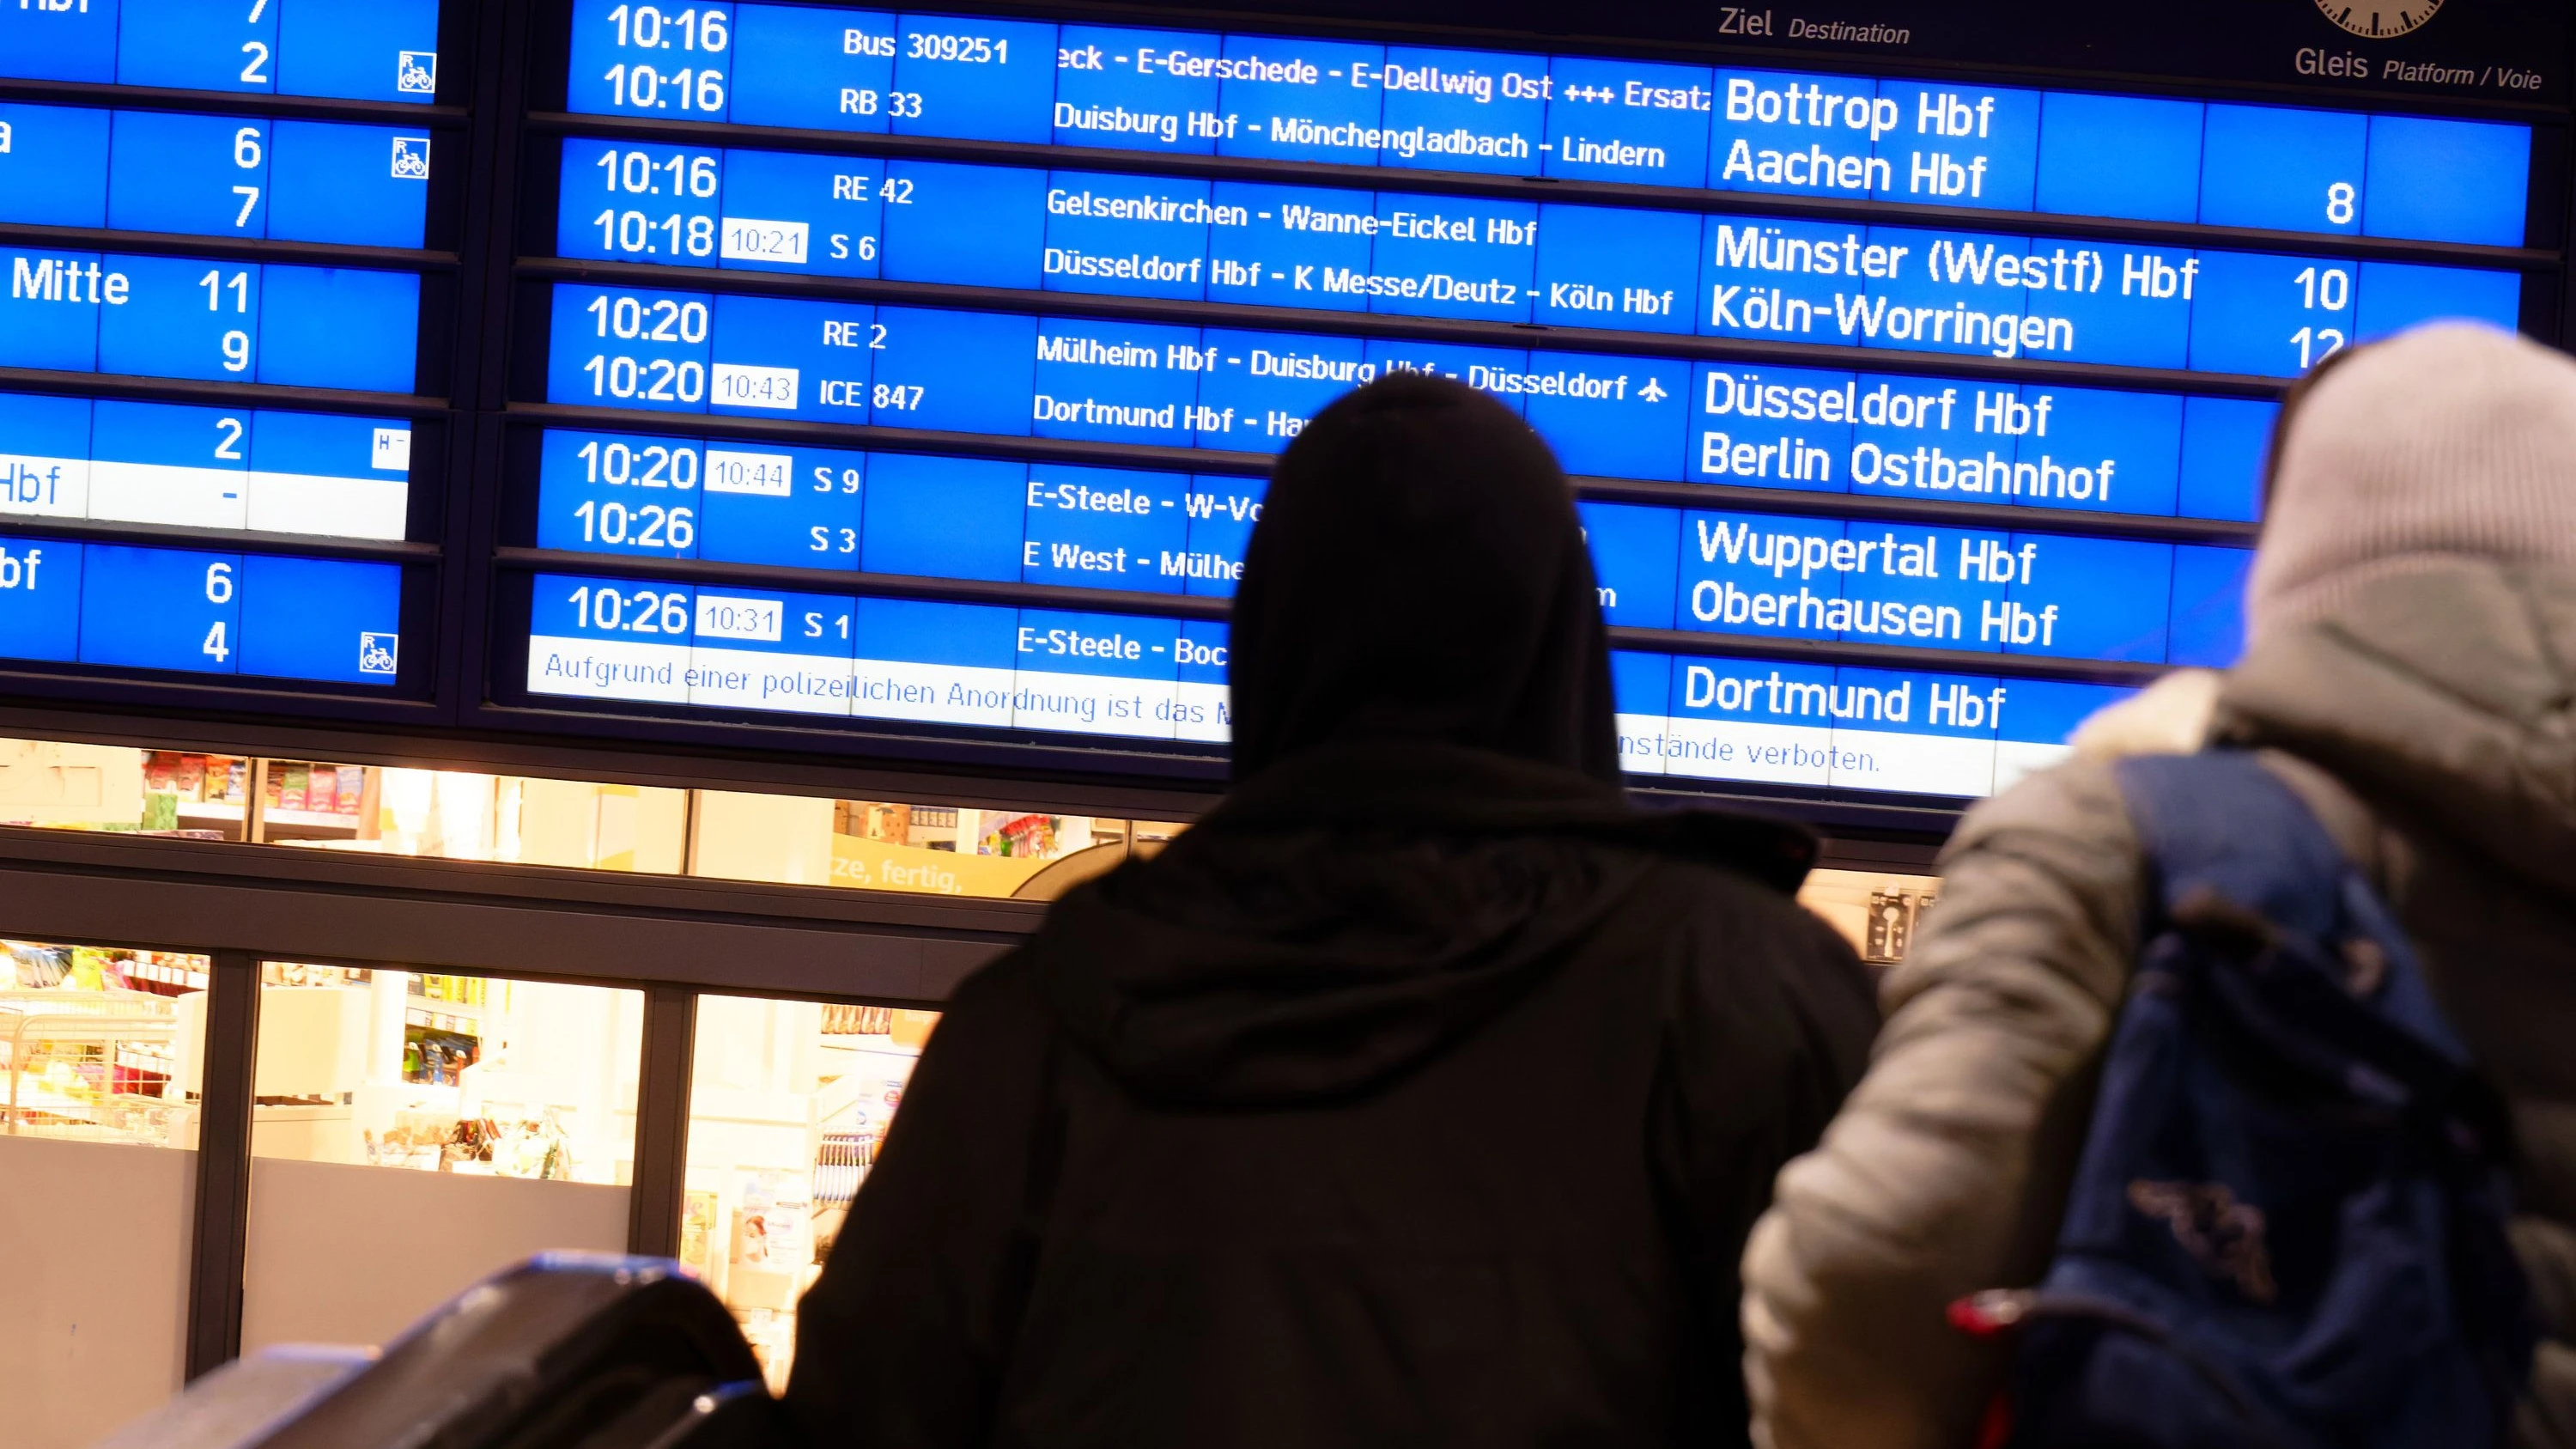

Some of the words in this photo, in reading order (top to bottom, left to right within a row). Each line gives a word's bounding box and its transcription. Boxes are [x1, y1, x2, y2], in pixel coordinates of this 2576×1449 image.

[607, 4, 728, 52] 10:16
[843, 28, 896, 57] Bus
[907, 33, 1007, 64] 309251
[1718, 7, 1773, 36] Ziel
[1788, 18, 1910, 44] Destination
[240, 41, 269, 83] 2
[1137, 48, 1318, 85] E-Gerschede
[1351, 62, 1492, 104] E-Dellwig
[1501, 72, 1553, 100] Ost
[1564, 84, 1615, 104] +++
[2295, 47, 2368, 78] Gleis
[2383, 60, 2475, 84] Platform
[2480, 66, 2492, 86] /
[2498, 67, 2542, 89] Voie
[604, 64, 724, 112] 10:16
[840, 88, 878, 115] RB
[888, 91, 922, 118] 33
[1726, 78, 1899, 142] Bottrop
[1917, 92, 1995, 138] Hbf
[234, 127, 261, 168] 6
[1054, 102, 1178, 143] Duisburg
[1188, 111, 1238, 139] Hbf
[1271, 116, 1528, 158] Mönchengladbach
[1563, 136, 1665, 167] Lindern
[597, 149, 717, 198] 10:16
[833, 174, 869, 201] RE
[879, 178, 914, 204] 42
[1722, 138, 1892, 192] Aachen
[1910, 151, 1988, 198] Hbf
[233, 186, 259, 228] 7
[1047, 189, 1248, 227] Gelsenkirchen
[1282, 204, 1477, 242] Wanne-Eickel
[1487, 218, 1537, 246] Hbf
[2326, 182, 2355, 224] 8
[593, 209, 714, 257] 10:18
[732, 228, 799, 255] 10:21
[830, 234, 849, 259] S
[859, 235, 876, 261] 6
[12, 257, 130, 305] Mitte
[1043, 248, 1201, 283] Düsseldorf
[1212, 259, 1261, 287] Hbf
[1294, 265, 1314, 290] K
[1323, 266, 1516, 305] Messe/Deutz
[1550, 283, 1613, 311] Köln
[1623, 288, 1674, 315] Hbf
[1716, 224, 1909, 279] Münster
[1928, 240, 2103, 293] (Westf)
[2122, 253, 2199, 300] Hbf
[199, 270, 247, 313] 11
[2293, 267, 2348, 311] 10
[587, 295, 708, 344] 10:20
[823, 320, 860, 347] RE
[869, 324, 887, 350] 2
[1711, 285, 2074, 359] Köln-Worringen
[222, 330, 249, 372] 9
[1036, 335, 1157, 368] Mülheim
[1167, 344, 1218, 372] Hbf
[1250, 350, 1376, 384] Duisburg
[1468, 365, 1628, 400] Düsseldorf
[2289, 326, 2345, 368] 12
[584, 355, 704, 403] 10:20
[720, 374, 791, 401] 10:43
[820, 380, 863, 407] ICE
[872, 384, 924, 411] 847
[1033, 394, 1175, 429] Dortmund
[1183, 405, 1234, 433] Hbf
[1267, 411, 1313, 436] Ha
[1705, 371, 1957, 430] Düsseldorf
[1974, 390, 2053, 437] Hbf
[215, 417, 242, 460] 2
[577, 441, 698, 490] 10:20
[714, 460, 783, 487] 10:44
[813, 466, 832, 492] S
[842, 469, 860, 494] 9
[1701, 431, 1831, 482] Berlin
[1850, 442, 2115, 502] Ostbahnhof
[1027, 482, 1151, 514] E-Steele
[574, 501, 694, 549] 10:26
[810, 526, 829, 551] S
[839, 528, 856, 553] 3
[1024, 541, 1042, 567] E
[1051, 543, 1127, 573] West
[1697, 520, 1939, 581] Wuppertal
[1959, 538, 2037, 585] Hbf
[206, 562, 233, 604] 6
[568, 586, 688, 634] 10:26
[704, 606, 774, 633] 10:31
[804, 612, 823, 637] S
[835, 614, 848, 639] 1
[1692, 580, 1961, 640] Oberhausen
[1980, 600, 2058, 646] Hbf
[203, 621, 229, 662] 4
[1018, 627, 1141, 660] E-Steele
[1174, 638, 1227, 666] Boc
[544, 653, 672, 688] Aufgrund
[683, 669, 748, 691] einer
[762, 673, 936, 704] polizeilichen
[947, 682, 1097, 722] Anordnung
[1107, 696, 1141, 719] ist
[1155, 698, 1205, 723] das
[1747, 744, 1880, 771] verboten.
[1686, 665, 1911, 722] Dortmund
[1929, 683, 2007, 729] Hbf
[830, 858, 872, 884] ze,
[881, 860, 962, 892] fertig,
